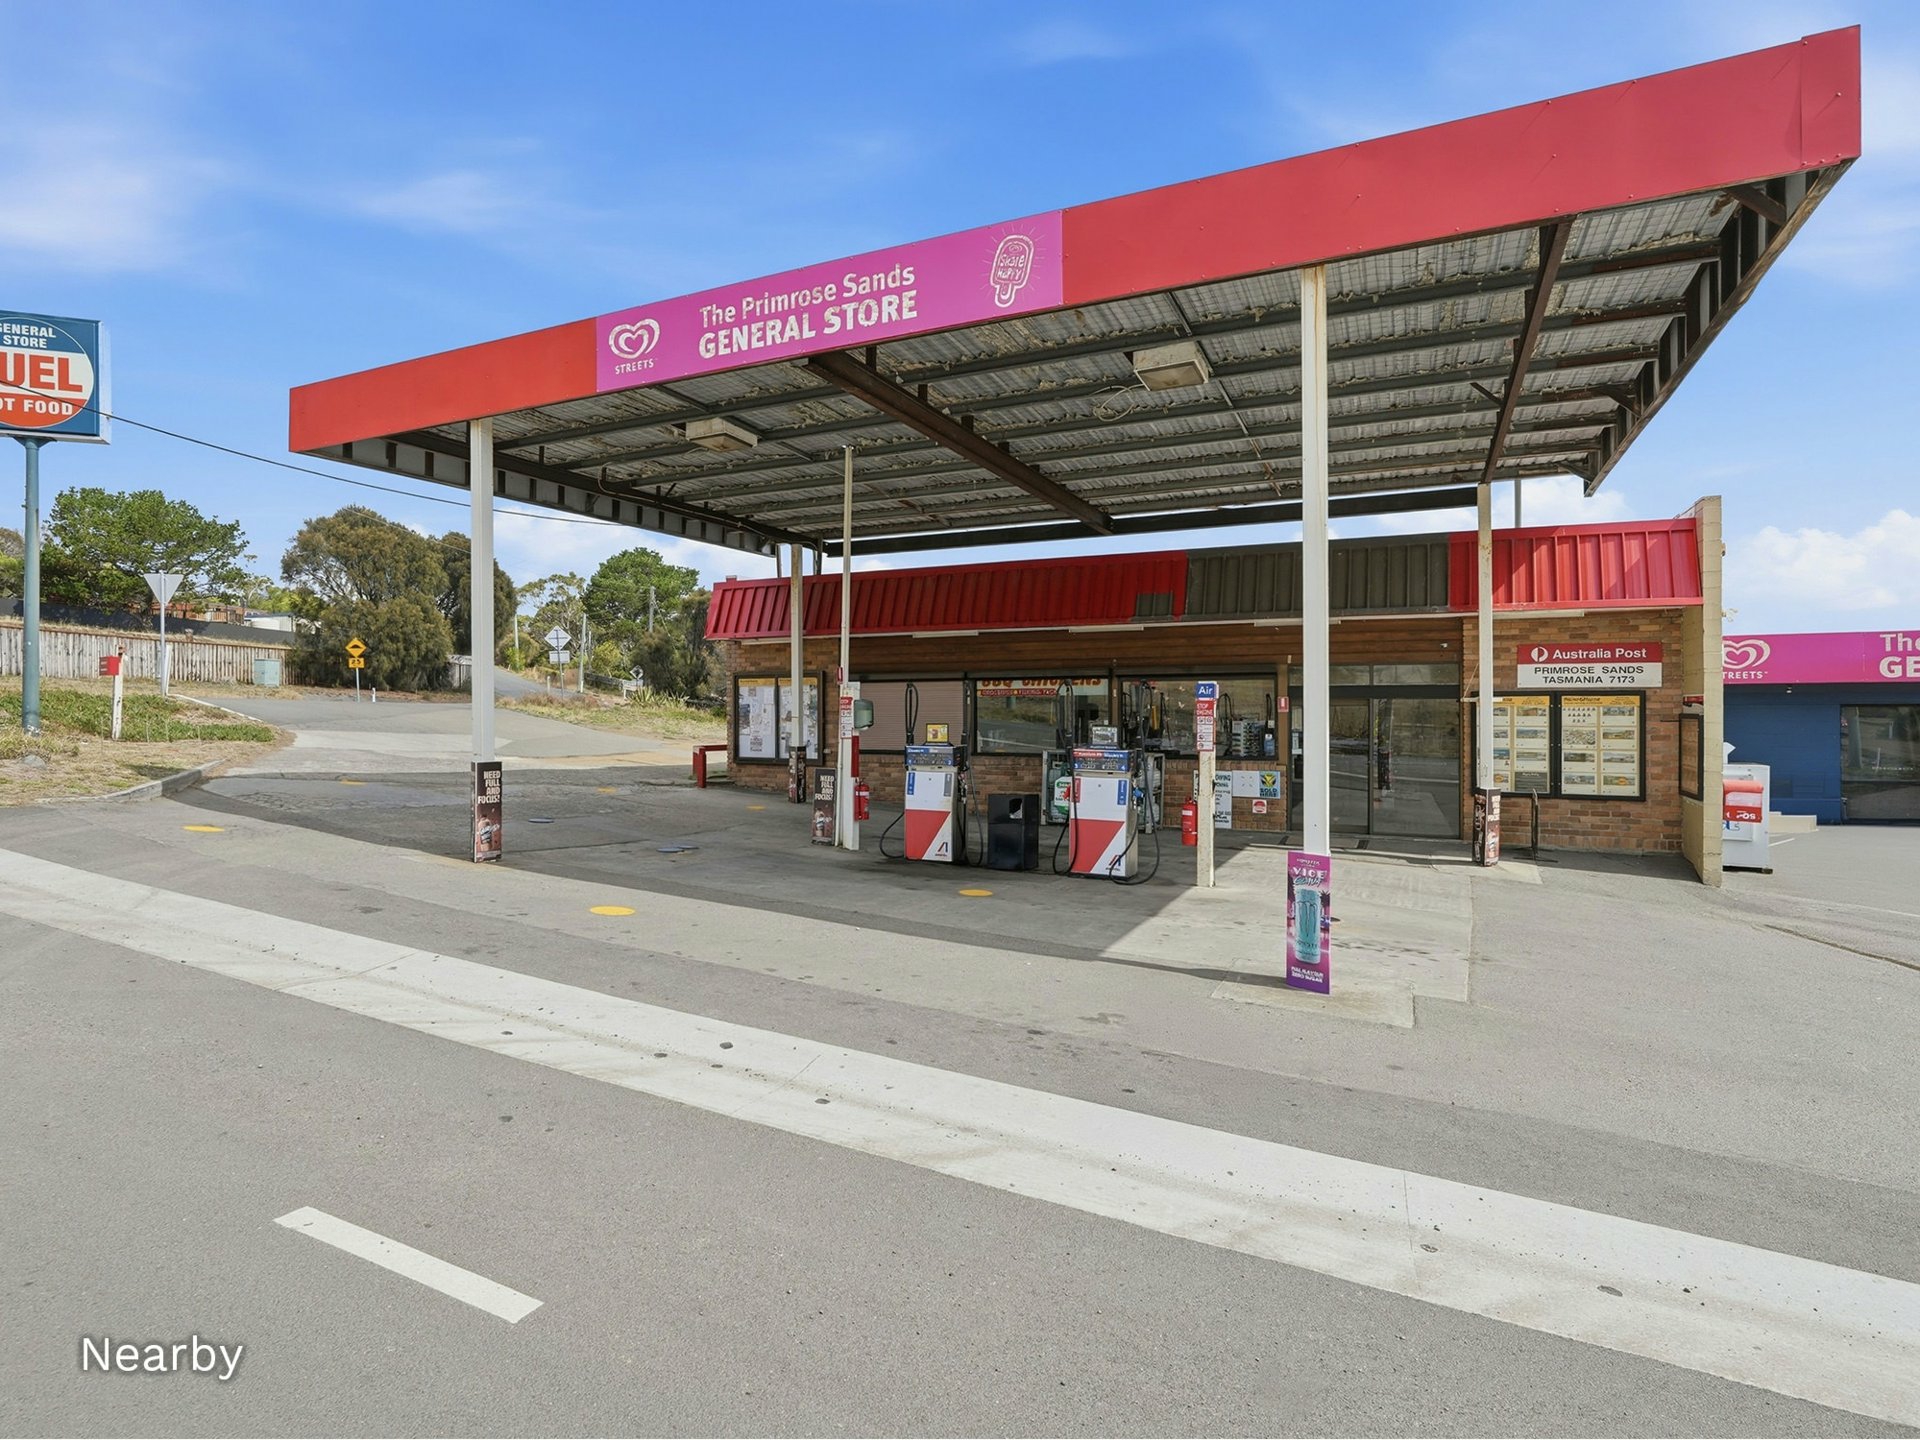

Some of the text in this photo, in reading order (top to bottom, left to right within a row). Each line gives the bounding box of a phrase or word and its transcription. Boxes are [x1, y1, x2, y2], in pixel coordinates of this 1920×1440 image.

[700, 263, 915, 328] The Primrose Sands
[699, 290, 918, 359] GENERAL STORE
[3, 335, 47, 349] STORE
[615, 358, 654, 375] STREETS
[23, 399, 73, 415] FOOD
[1553, 648, 1647, 660] Australia Post
[1534, 666, 1644, 674] PRIMROSE SANDS
[1542, 676, 1635, 684] TASMANIA 7173
[1198, 686, 1213, 695] Air
[484, 771, 500, 779] NEED
[485, 779, 500, 787] FULL
[486, 787, 500, 795] AND
[1293, 867, 1324, 879] VICE
